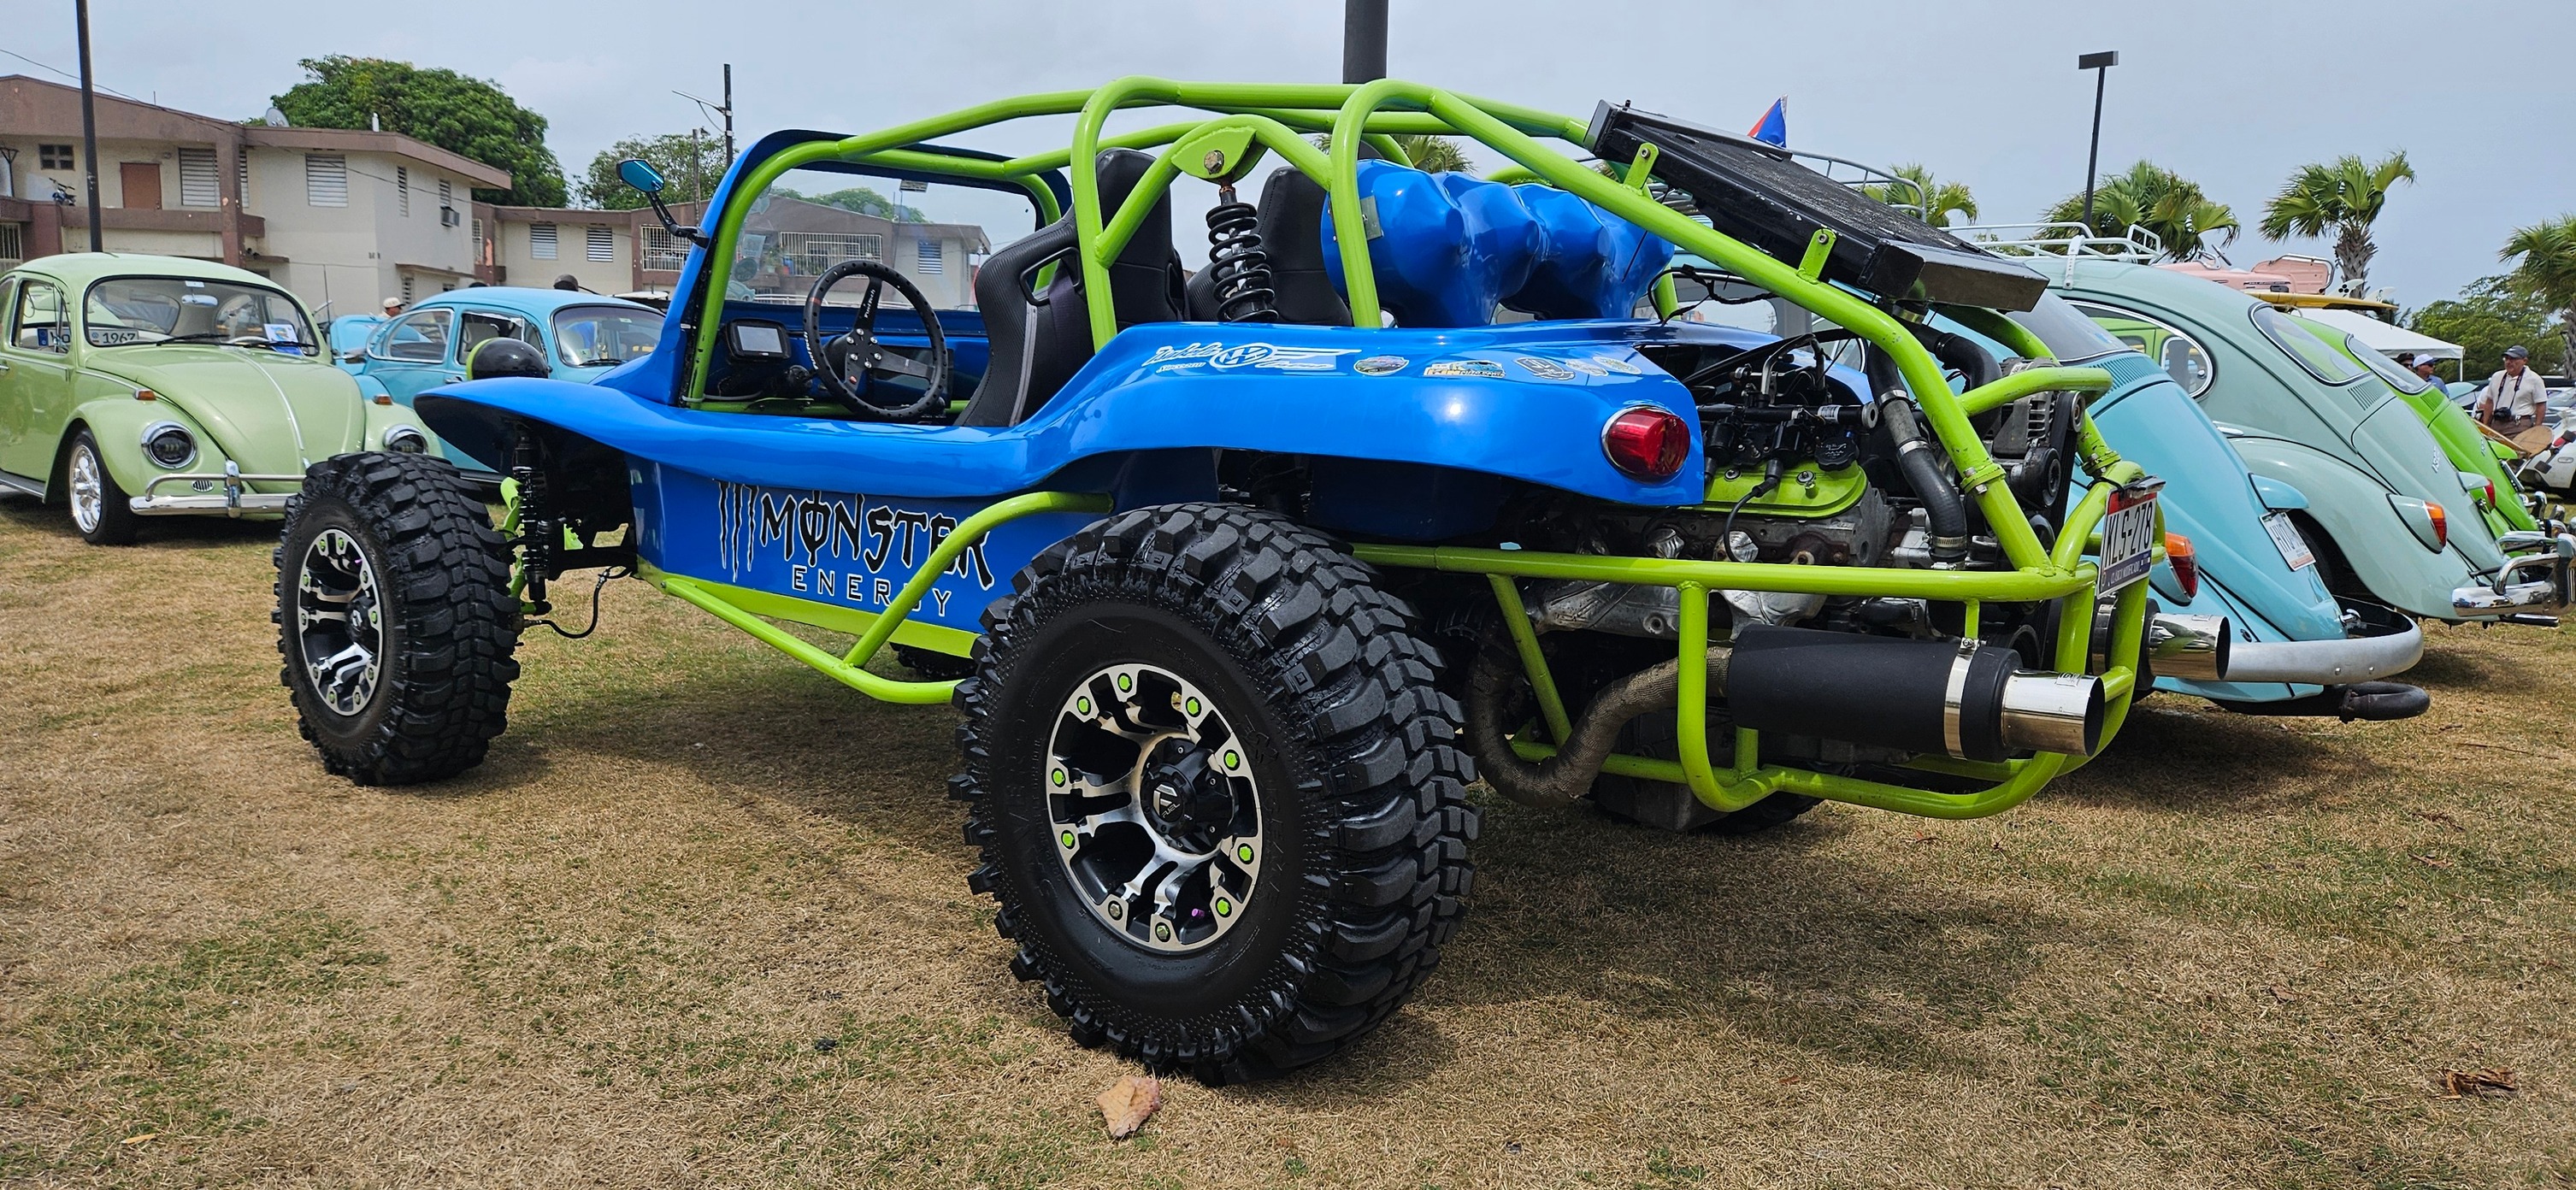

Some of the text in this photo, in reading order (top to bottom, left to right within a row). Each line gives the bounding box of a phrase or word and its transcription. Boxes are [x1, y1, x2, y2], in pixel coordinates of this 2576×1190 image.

[103, 333, 136, 344] 1967
[2104, 501, 2153, 568] KLS-278
[792, 564, 952, 617] ENERY
[1161, 803, 1181, 818] FUEL
